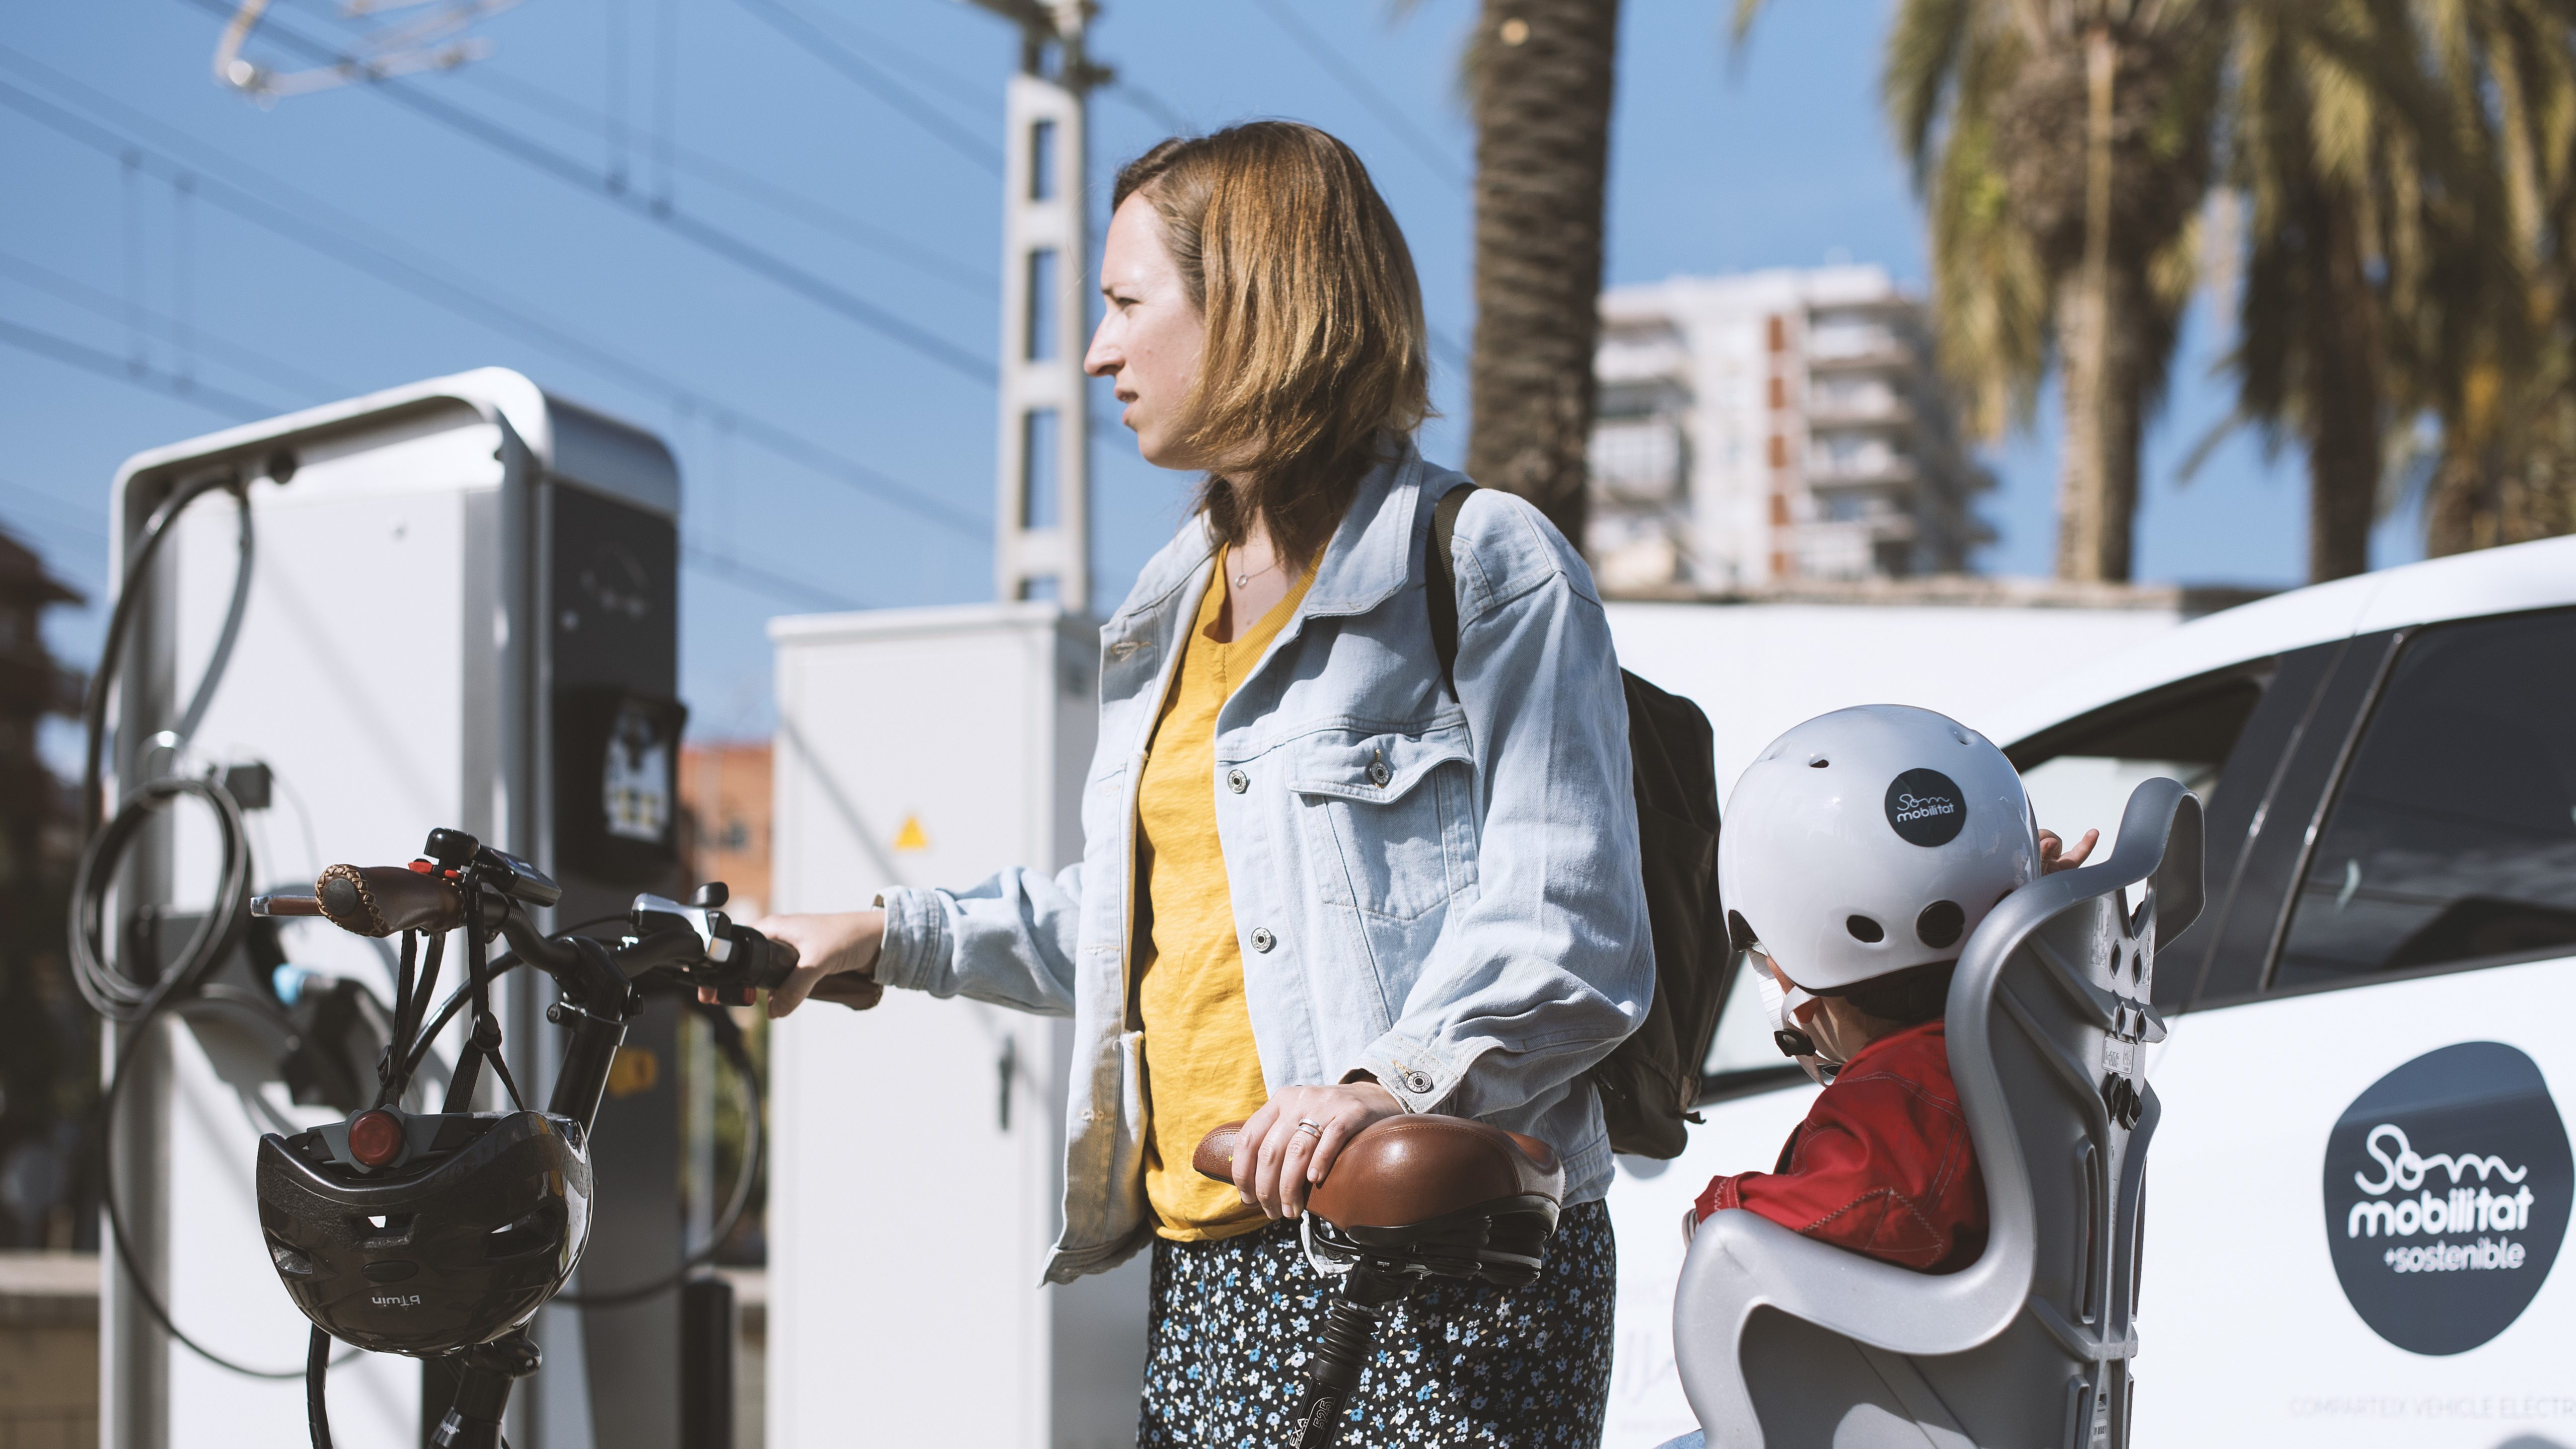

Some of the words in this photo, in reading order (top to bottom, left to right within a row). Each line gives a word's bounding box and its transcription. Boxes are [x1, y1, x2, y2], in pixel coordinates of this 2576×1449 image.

[1896, 803, 1954, 822] mobilitat
[1897, 793, 1950, 811] Som
[2354, 1123, 2528, 1195] Som
[2347, 1185, 2535, 1238] mobilitat
[1313, 1400, 1335, 1429] 525
[2413, 1394, 2495, 1419] VEHICLE
[1289, 1418, 1306, 1446] EXA
